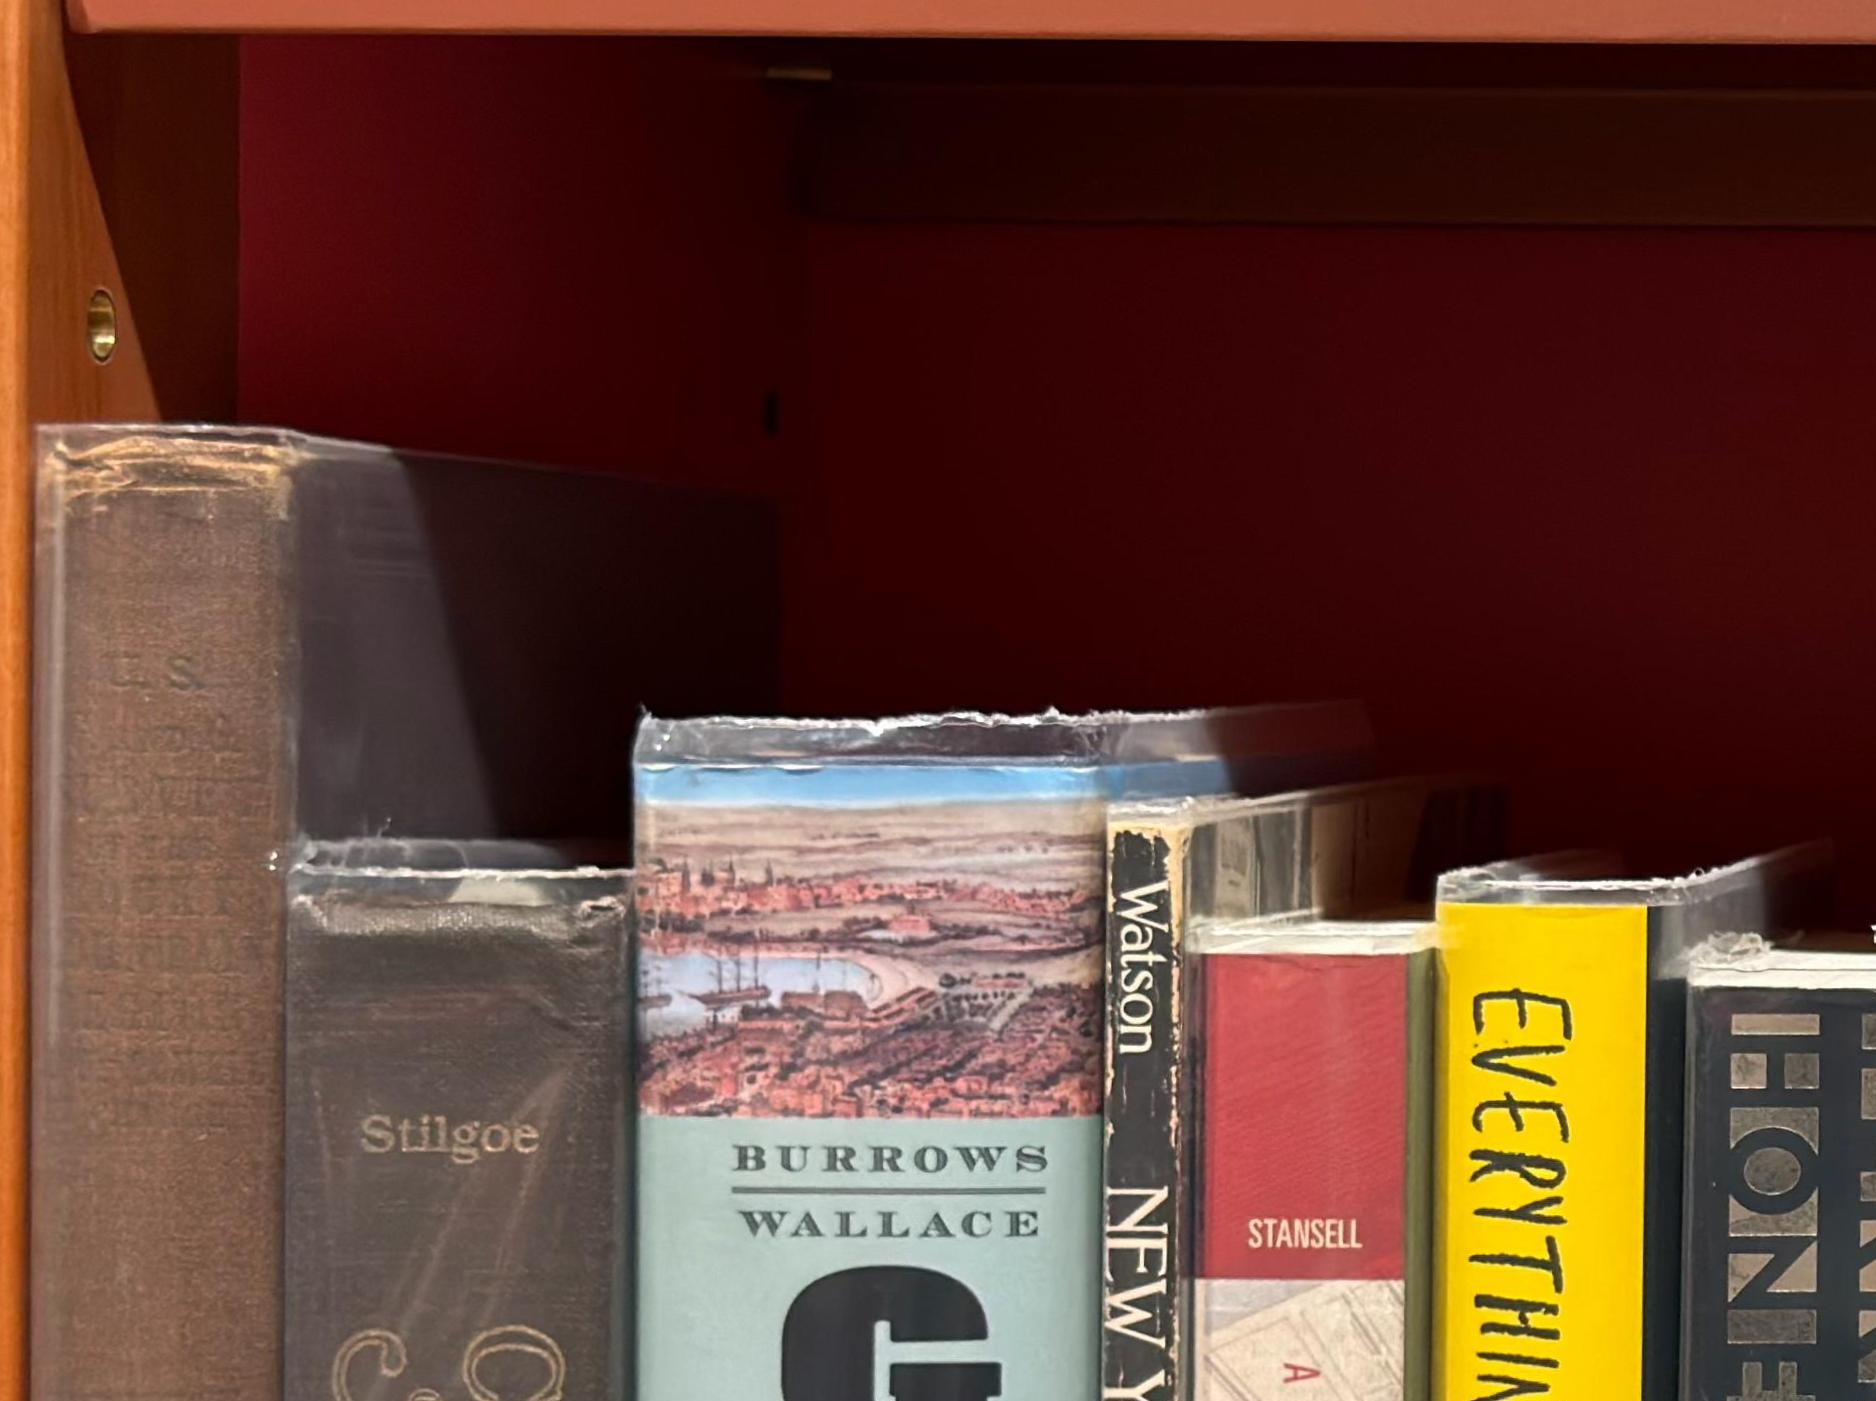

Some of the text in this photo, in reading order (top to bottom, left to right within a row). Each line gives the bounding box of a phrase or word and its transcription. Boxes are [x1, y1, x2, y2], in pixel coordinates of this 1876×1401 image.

[1115, 882, 1169, 1056] Watson
[360, 1114, 541, 1165] Stilgoe
[732, 1144, 1049, 1174] BURROWS
[738, 1210, 1040, 1238] WALLACE
[1247, 1218, 1363, 1250] STANSELL
[1104, 1185, 1169, 1348] NEW
